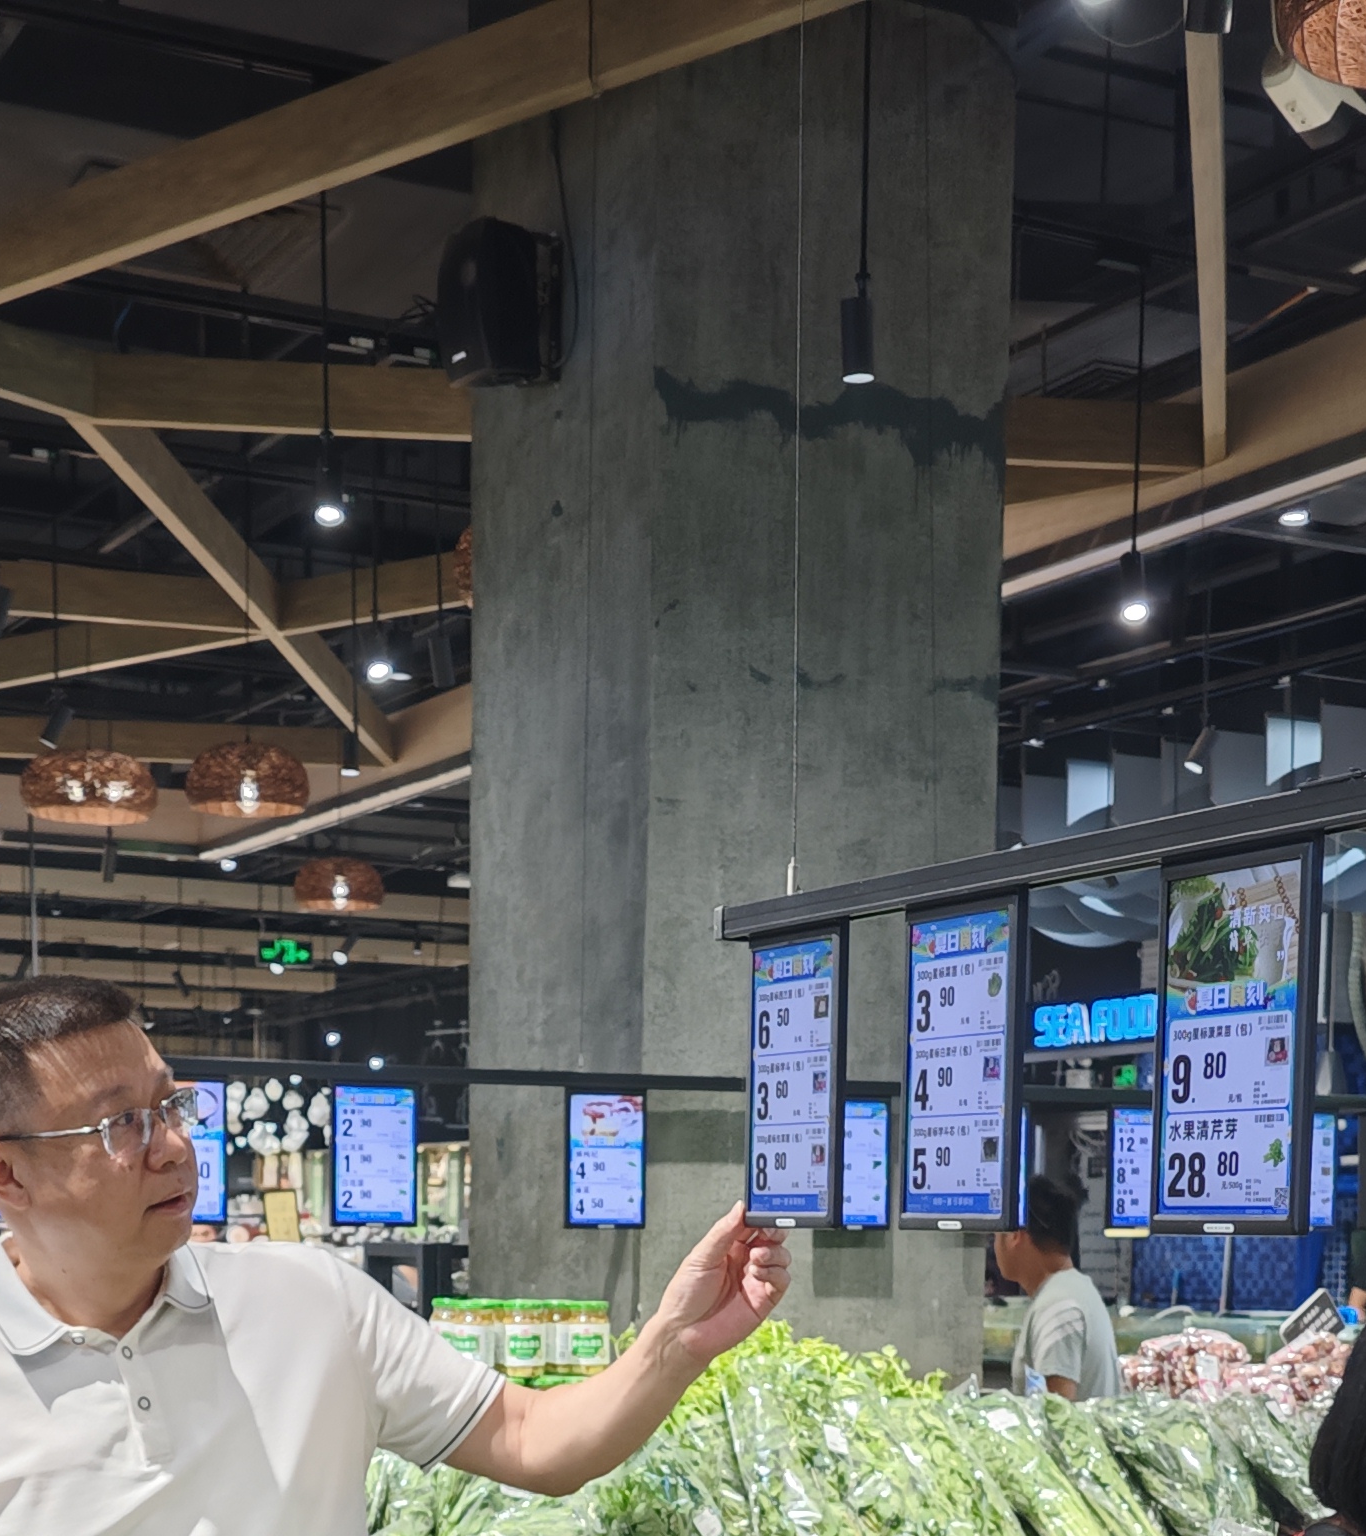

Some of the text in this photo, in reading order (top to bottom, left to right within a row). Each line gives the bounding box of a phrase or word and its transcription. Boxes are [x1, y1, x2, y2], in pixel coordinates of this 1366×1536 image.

[1196, 980, 1266, 1012] 夏日食刻
[1035, 1002, 1090, 1048] SEA
[1092, 993, 1158, 1043] FOOD
[1168, 1118, 1238, 1141] 水果清芹芽
